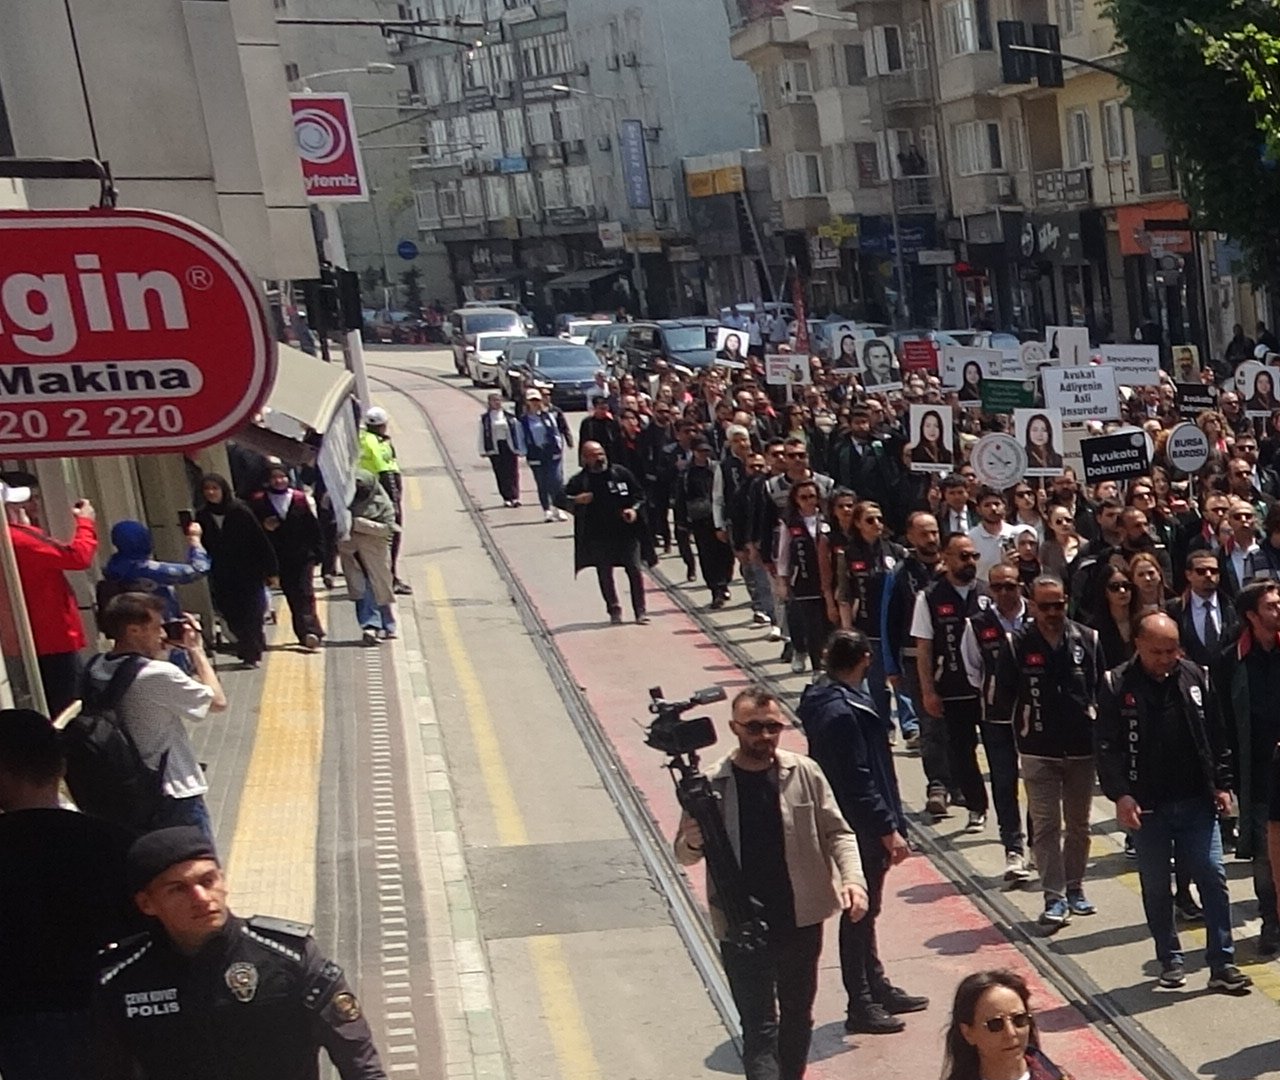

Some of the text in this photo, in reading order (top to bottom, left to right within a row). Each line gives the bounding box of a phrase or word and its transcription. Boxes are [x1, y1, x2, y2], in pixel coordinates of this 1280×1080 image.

[0, 253, 190, 356] gin
[0, 363, 191, 396] Makina
[62, 408, 91, 437] 2
[104, 404, 184, 436] 220
[1174, 438, 1204, 448] BURSA
[1091, 449, 1139, 463] Avukata
[1172, 448, 1208, 459] BAROSU
[1087, 461, 1141, 477] Dokunma
